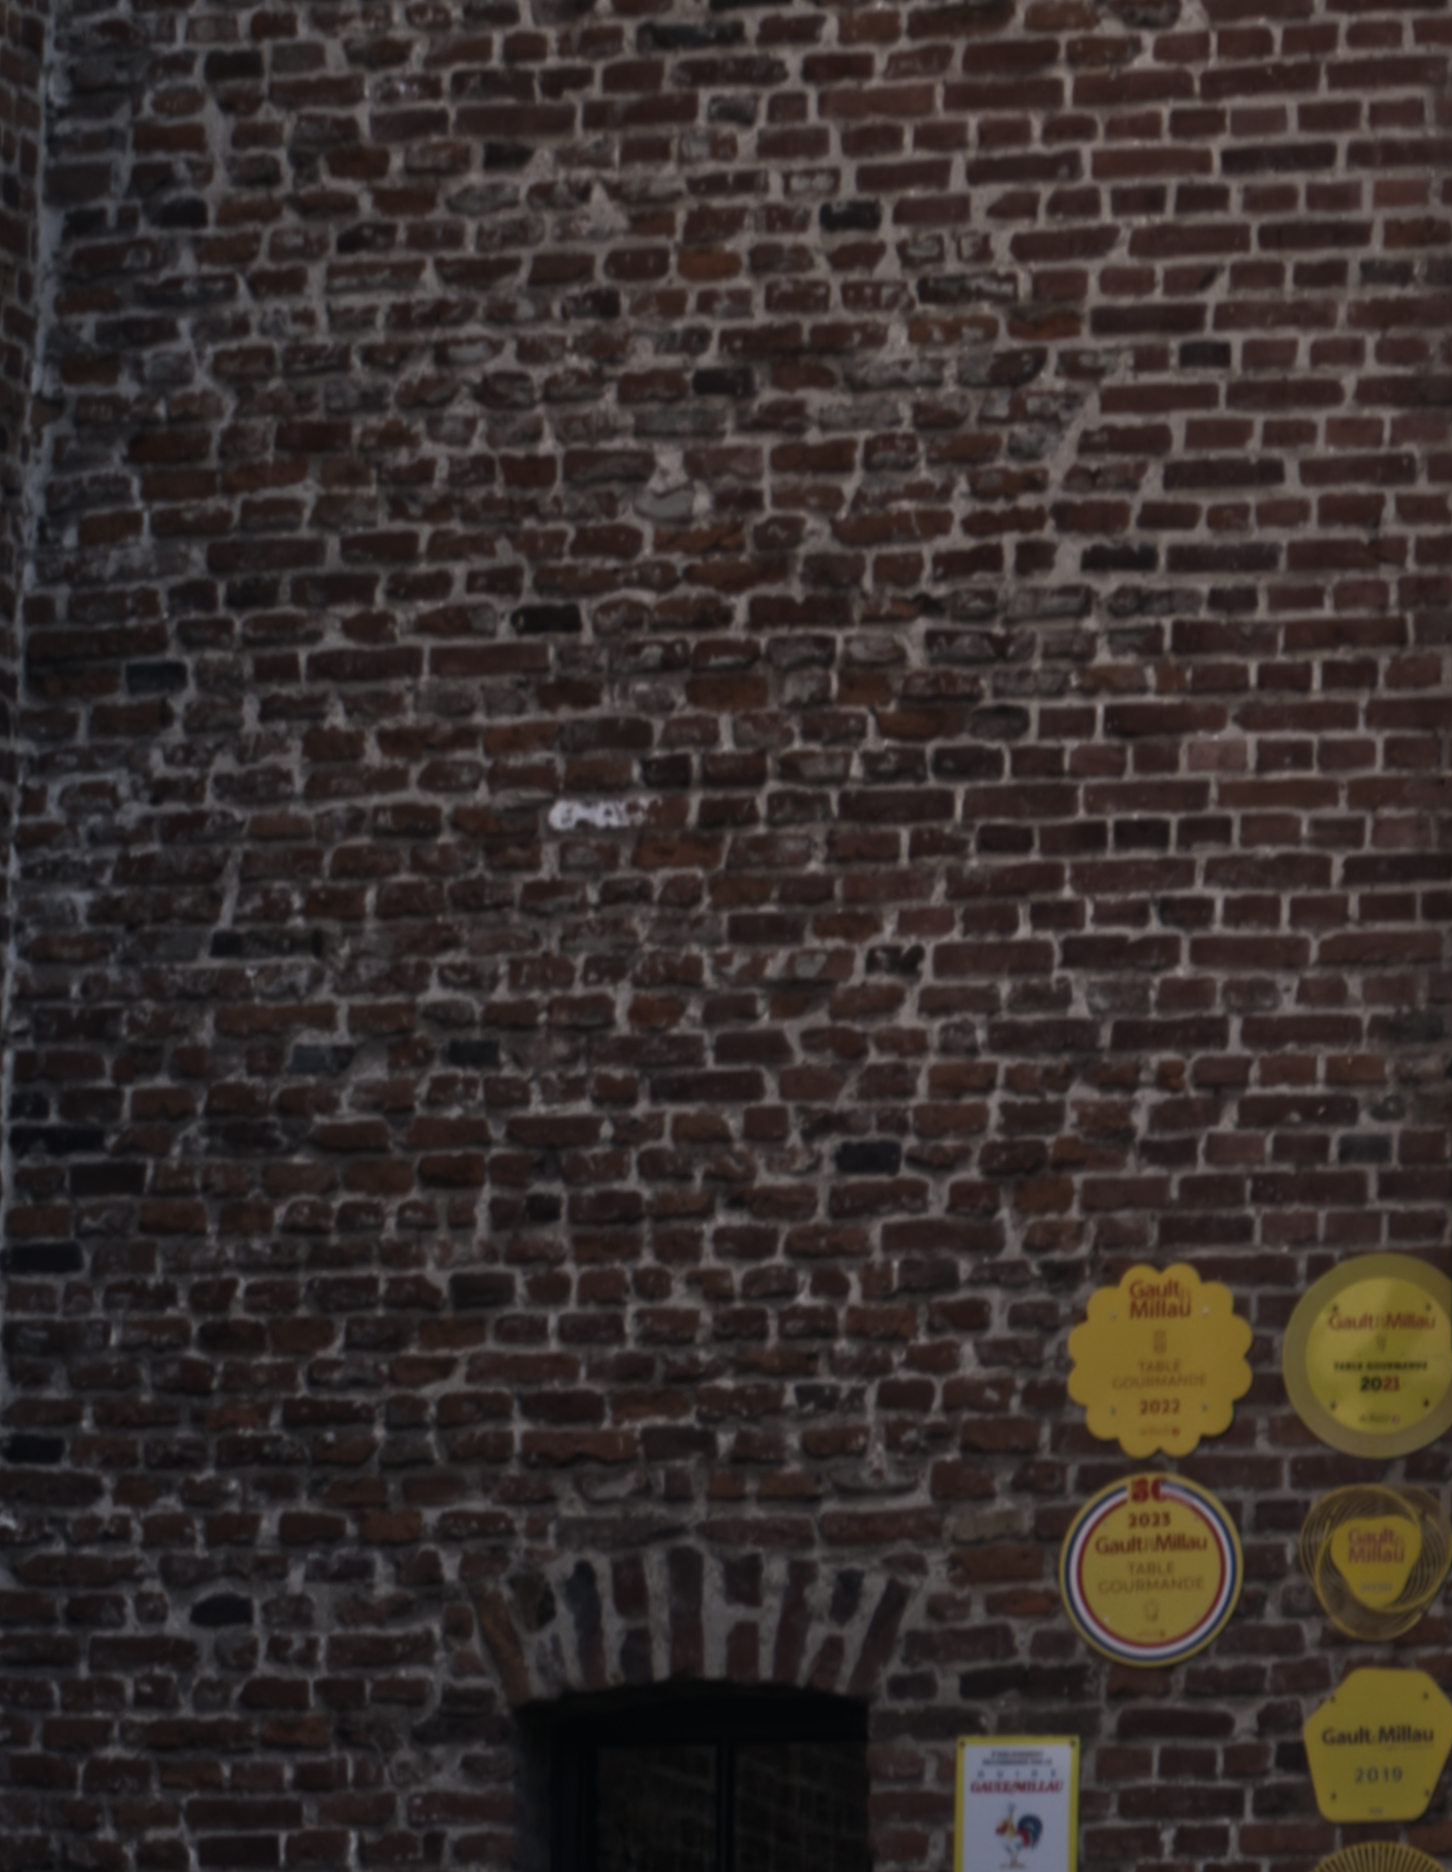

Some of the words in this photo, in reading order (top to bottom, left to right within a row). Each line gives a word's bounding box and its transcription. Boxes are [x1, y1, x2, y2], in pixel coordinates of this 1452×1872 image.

[1128, 1278, 1183, 1303] Gault
[1128, 1296, 1192, 1320] Millau
[1359, 1376, 1400, 1392] 2021
[1140, 1398, 1181, 1415] 2022
[1128, 1512, 1171, 1528] 2023
[1127, 1560, 1174, 1576] TABLE
[1356, 1766, 1404, 1784] 2019
